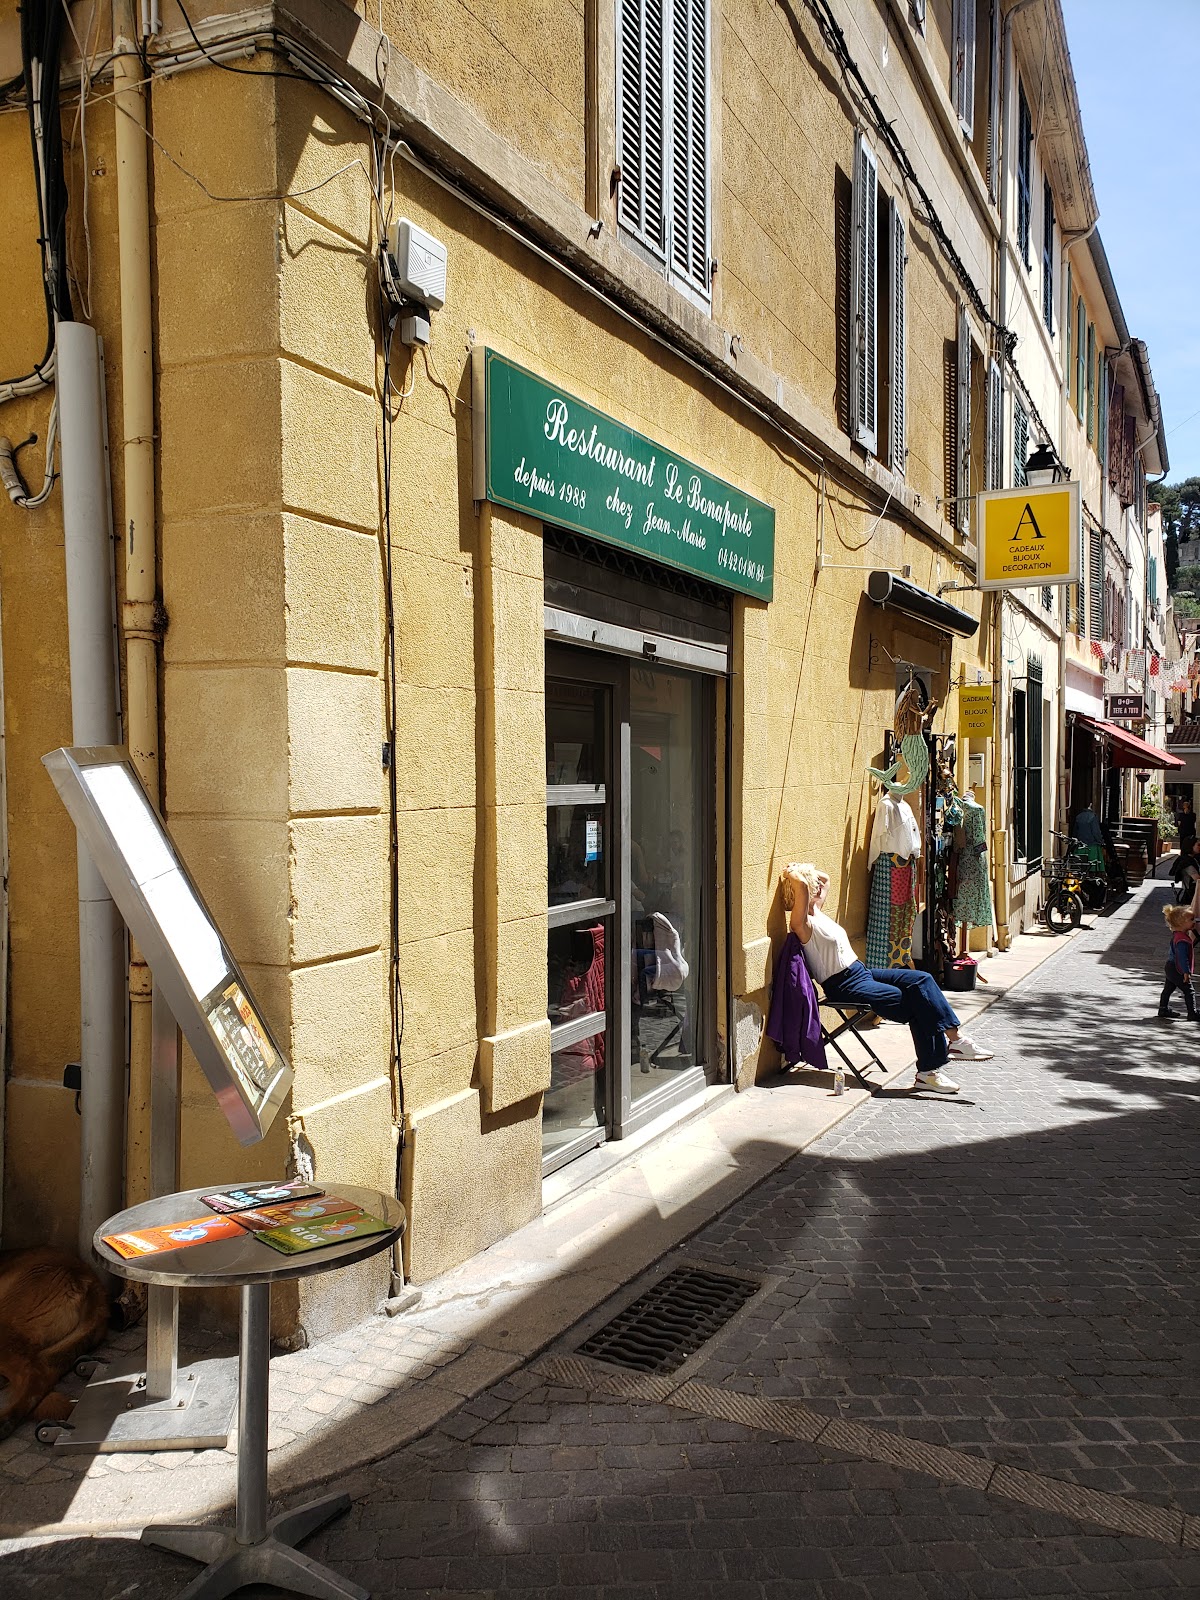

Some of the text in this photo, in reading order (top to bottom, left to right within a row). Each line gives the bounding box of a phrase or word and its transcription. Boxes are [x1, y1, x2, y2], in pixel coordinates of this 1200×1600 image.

[544, 399, 752, 537] Restaurant Le Bonaparte
[514, 457, 555, 498] depuis
[559, 482, 586, 509] 1988
[606, 486, 633, 529] chez
[643, 502, 706, 550] Jean-Marie
[1008, 503, 1046, 541] A
[1009, 544, 1045, 553] CADEAUX
[1013, 553, 1041, 562] BIJOUX
[1002, 561, 1052, 572] DECORATION
[962, 695, 990, 703] CADEAUX
[964, 708, 988, 716] BIJOUX
[289, 1226, 326, 1244] 2019
